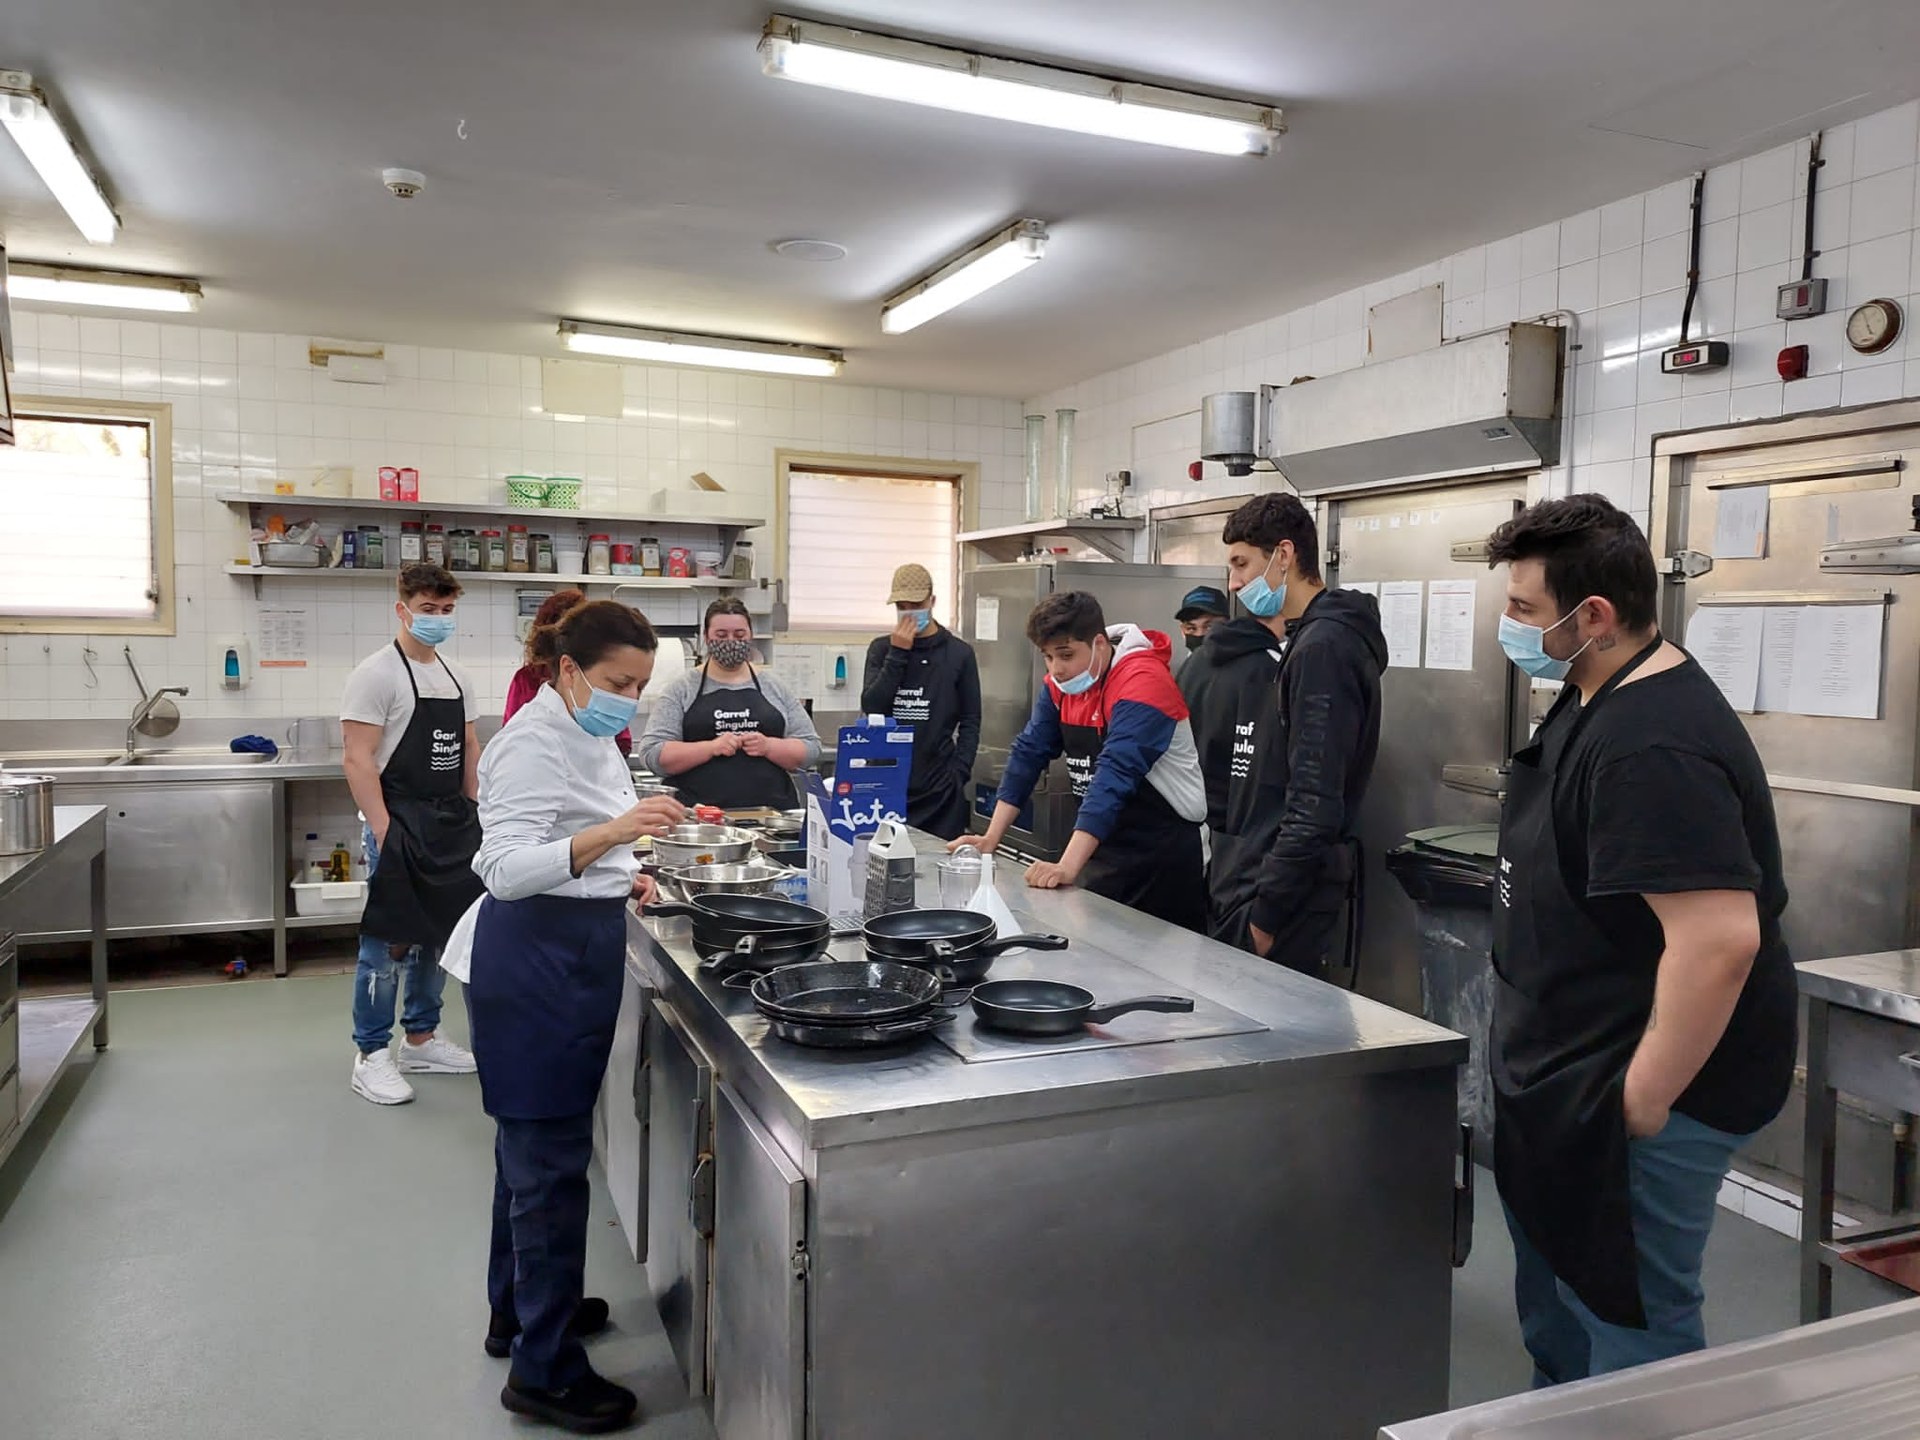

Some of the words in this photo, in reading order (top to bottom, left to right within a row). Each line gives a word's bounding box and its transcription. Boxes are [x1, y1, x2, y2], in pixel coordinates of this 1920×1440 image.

[714, 708, 751, 719] Garraf
[715, 719, 760, 730] Singular
[831, 798, 907, 832] Jata
